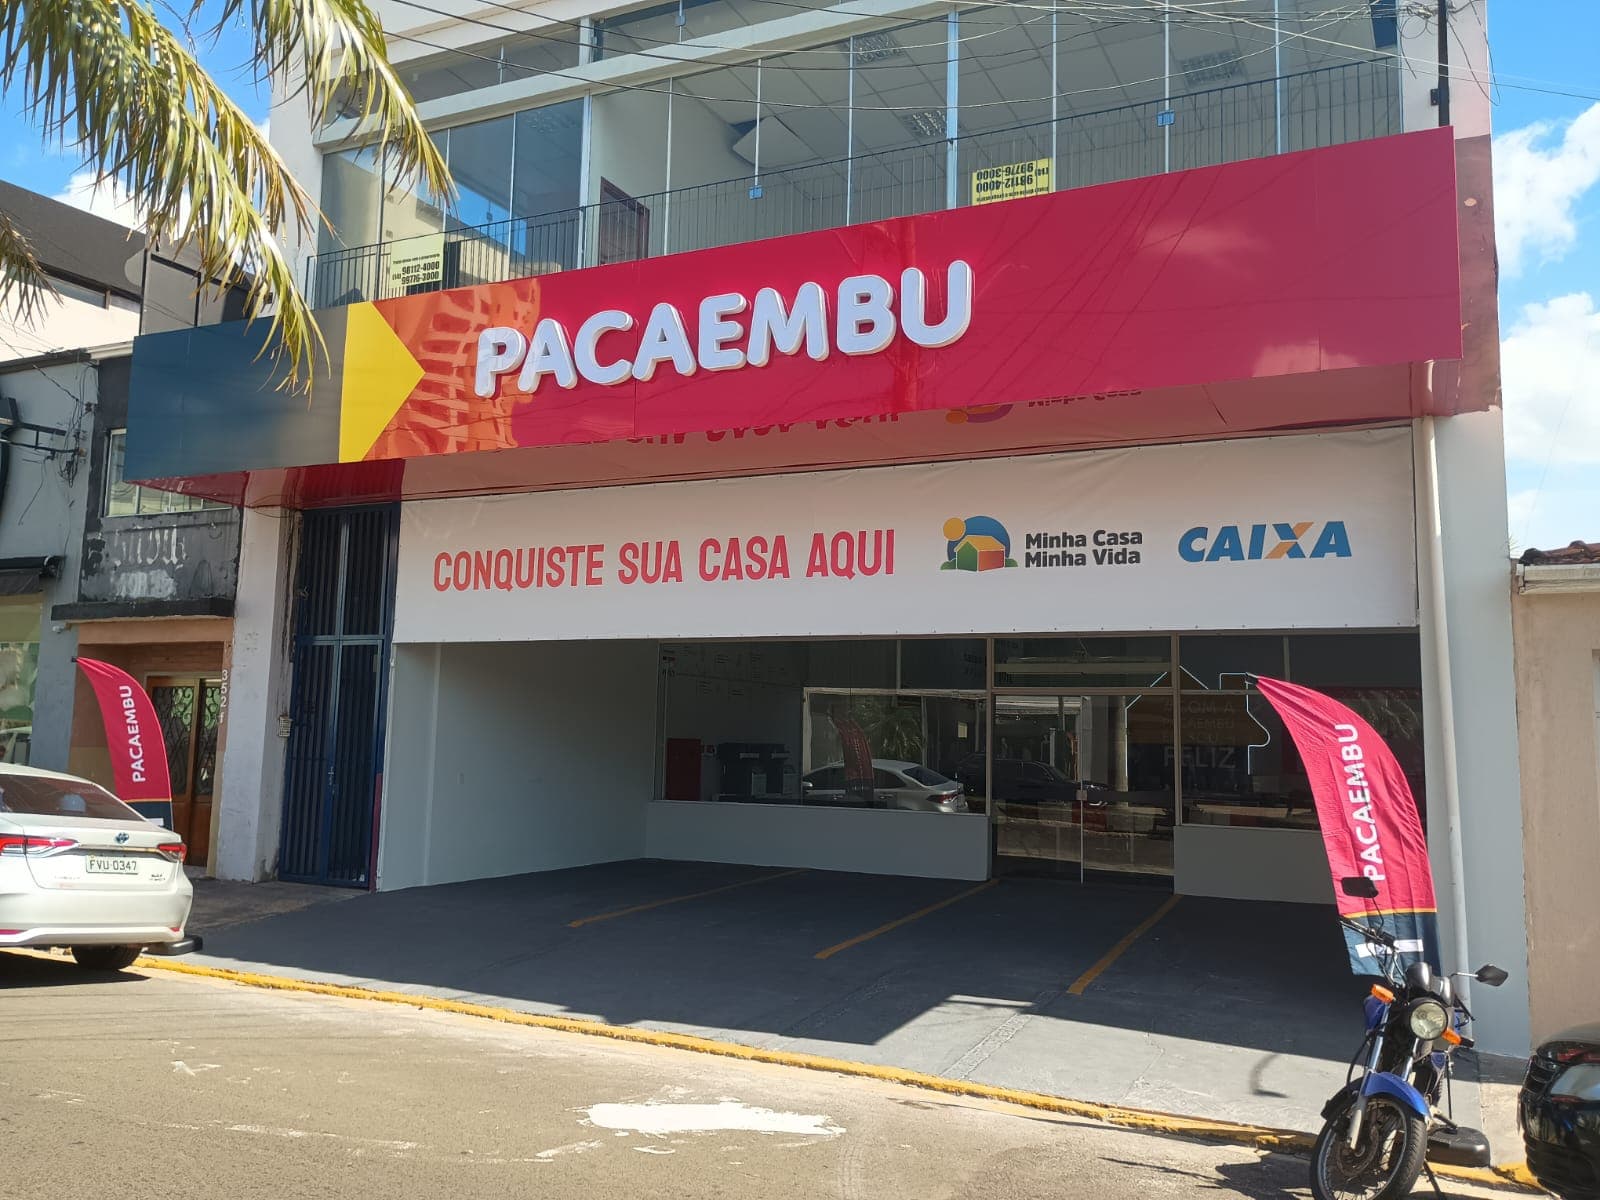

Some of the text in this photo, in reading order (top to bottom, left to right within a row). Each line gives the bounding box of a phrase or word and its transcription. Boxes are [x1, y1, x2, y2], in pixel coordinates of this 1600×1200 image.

[976, 162, 1034, 181] 99776-3000
[976, 174, 1033, 193] 98112-4000
[402, 261, 440, 275] 98112-4000
[474, 260, 972, 398] PACAEMBU
[1025, 529, 1143, 549] Minha Casa
[1178, 521, 1352, 562] CAIXA
[433, 529, 895, 592] CONQUISTE SUA CASA AQUI
[1025, 547, 1141, 568] Minha Vida
[119, 685, 146, 782] PACAEMBU
[1334, 723, 1386, 882] PACAEMBU
